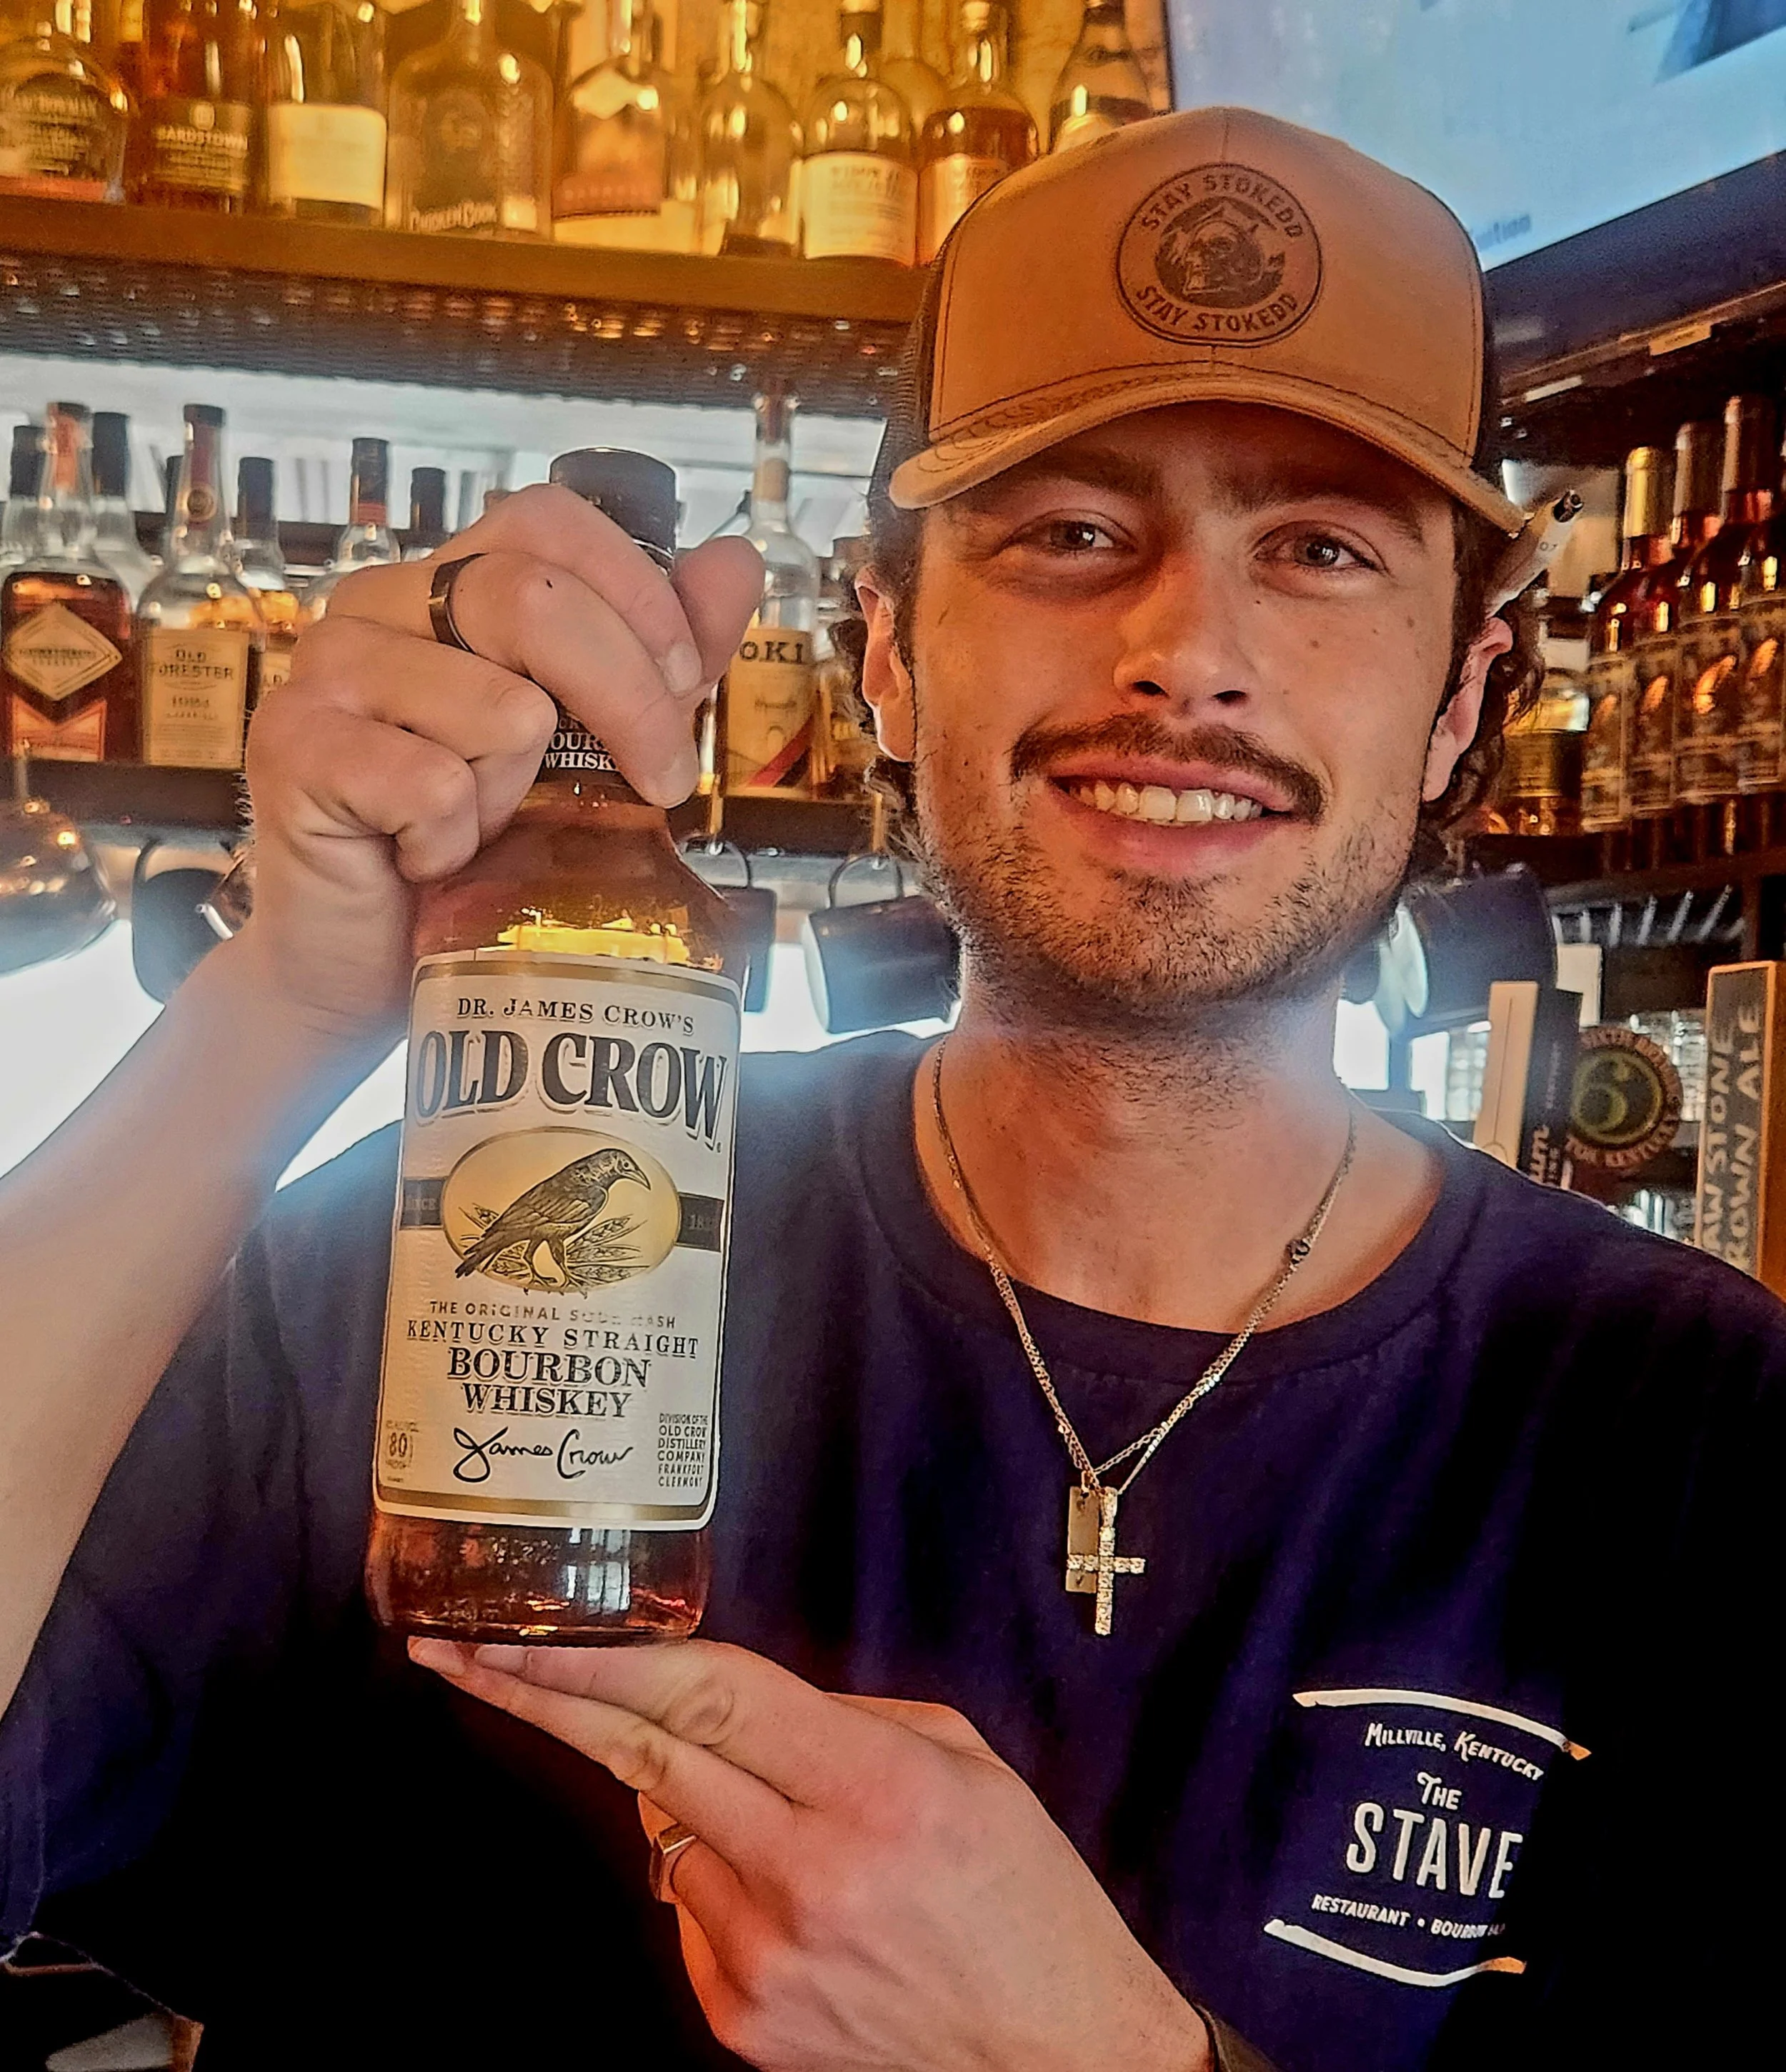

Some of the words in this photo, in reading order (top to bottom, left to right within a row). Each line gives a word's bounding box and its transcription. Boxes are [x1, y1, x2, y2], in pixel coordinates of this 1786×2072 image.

[1141, 182, 1194, 231] STAY
[1202, 173, 1304, 238] STOKEDD
[1136, 285, 1189, 326] STAY
[1194, 292, 1299, 333] STOKEDD
[176, 648, 206, 663] OLD
[545, 751, 619, 771] WHISK
[457, 998, 494, 1019] DR.
[503, 998, 594, 1022] JAMES
[604, 1004, 694, 1035] CROW'S
[1737, 1005, 1762, 1101] ALE
[416, 1030, 529, 1118] OLD
[1703, 1024, 1736, 1252] AWSTONE
[1724, 1123, 1757, 1268] ROWN
[430, 1301, 458, 1314] THE
[465, 1302, 561, 1321] ORIGINAL
[408, 1320, 549, 1346] KENTUCKY
[564, 1328, 699, 1357] STRAIGHT
[448, 1346, 651, 1388] BOURBON
[462, 1382, 632, 1418] WHISKEY
[389, 1431, 408, 1458] 80
[659, 1425, 682, 1437] OLD
[452, 1426, 553, 1483] James
[557, 1428, 634, 1479] Crow
[1365, 1722, 1446, 1752] MILLVILLE,
[1455, 1730, 1544, 1781] KENTUCKY
[1417, 1771, 1462, 1810] THE
[1346, 1801, 1523, 1898] STAVE
[1311, 1893, 1411, 1927] RESTAURANT
